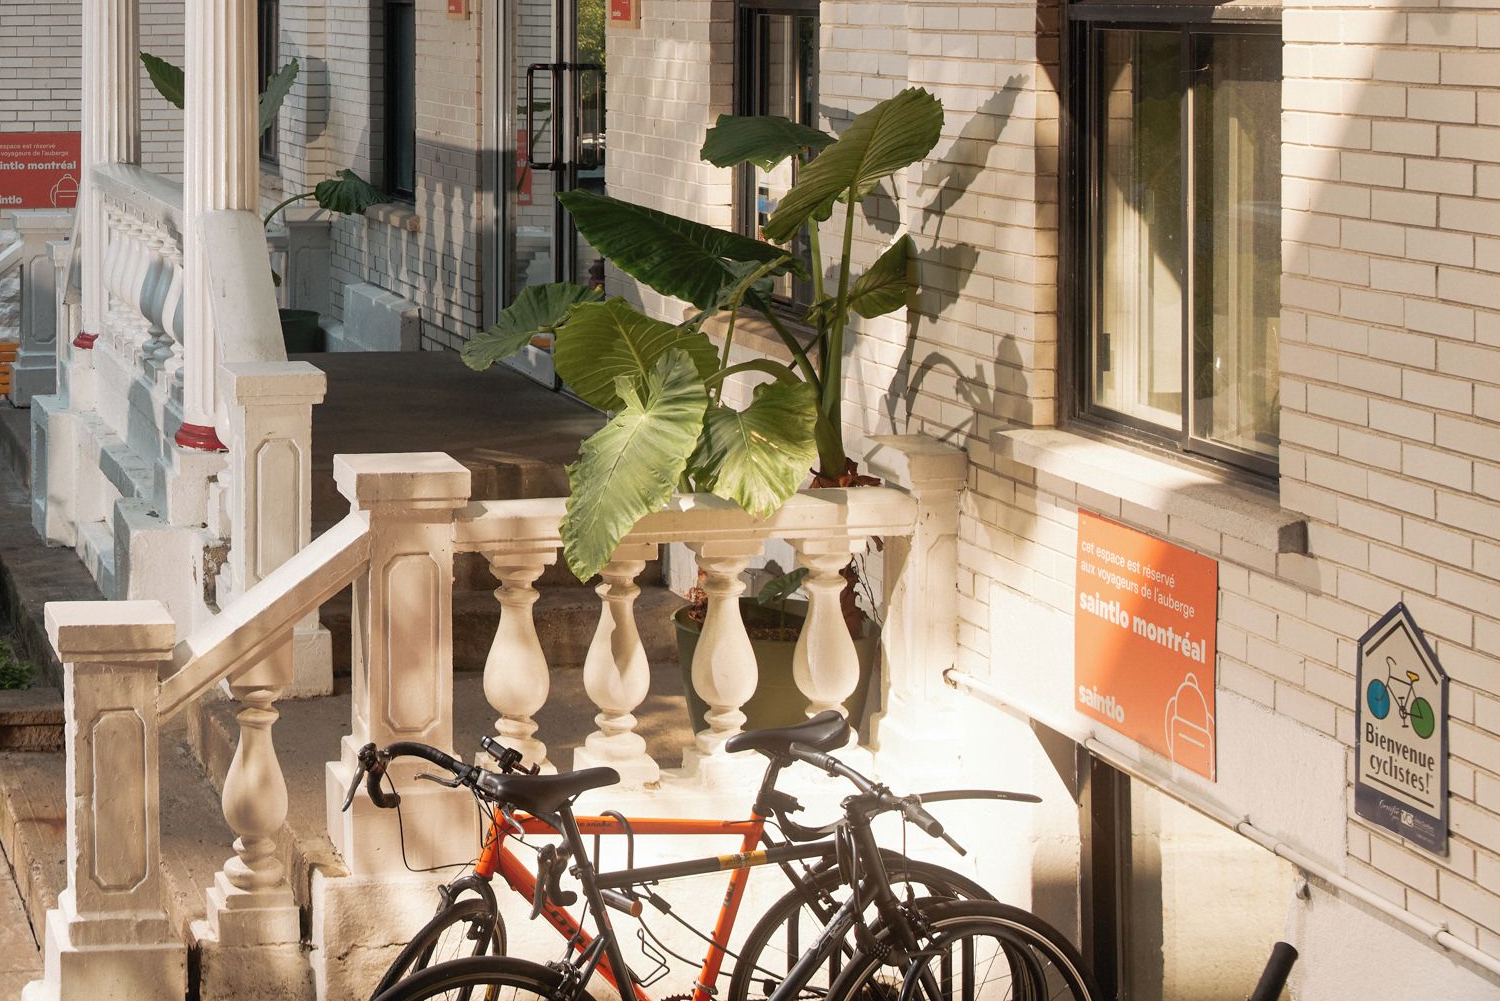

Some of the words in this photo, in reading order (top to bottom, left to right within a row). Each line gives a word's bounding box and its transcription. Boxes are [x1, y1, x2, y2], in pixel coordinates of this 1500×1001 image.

[27, 160, 77, 170] montréal
[1081, 540, 1095, 556] cet
[1096, 545, 1125, 567] espace
[1126, 558, 1141, 574] est
[1142, 564, 1175, 588] réservé
[1081, 560, 1095, 576] aux
[1097, 566, 1139, 594] voyageurs
[1141, 583, 1152, 599] de
[1153, 587, 1195, 618] l'auberge
[1079, 591, 1129, 629] saintlo
[1133, 616, 1206, 664] montréal
[1078, 684, 1125, 724] saintlo
[1365, 721, 1435, 771] Bienvenue
[1369, 754, 1430, 795] cyclistes!
